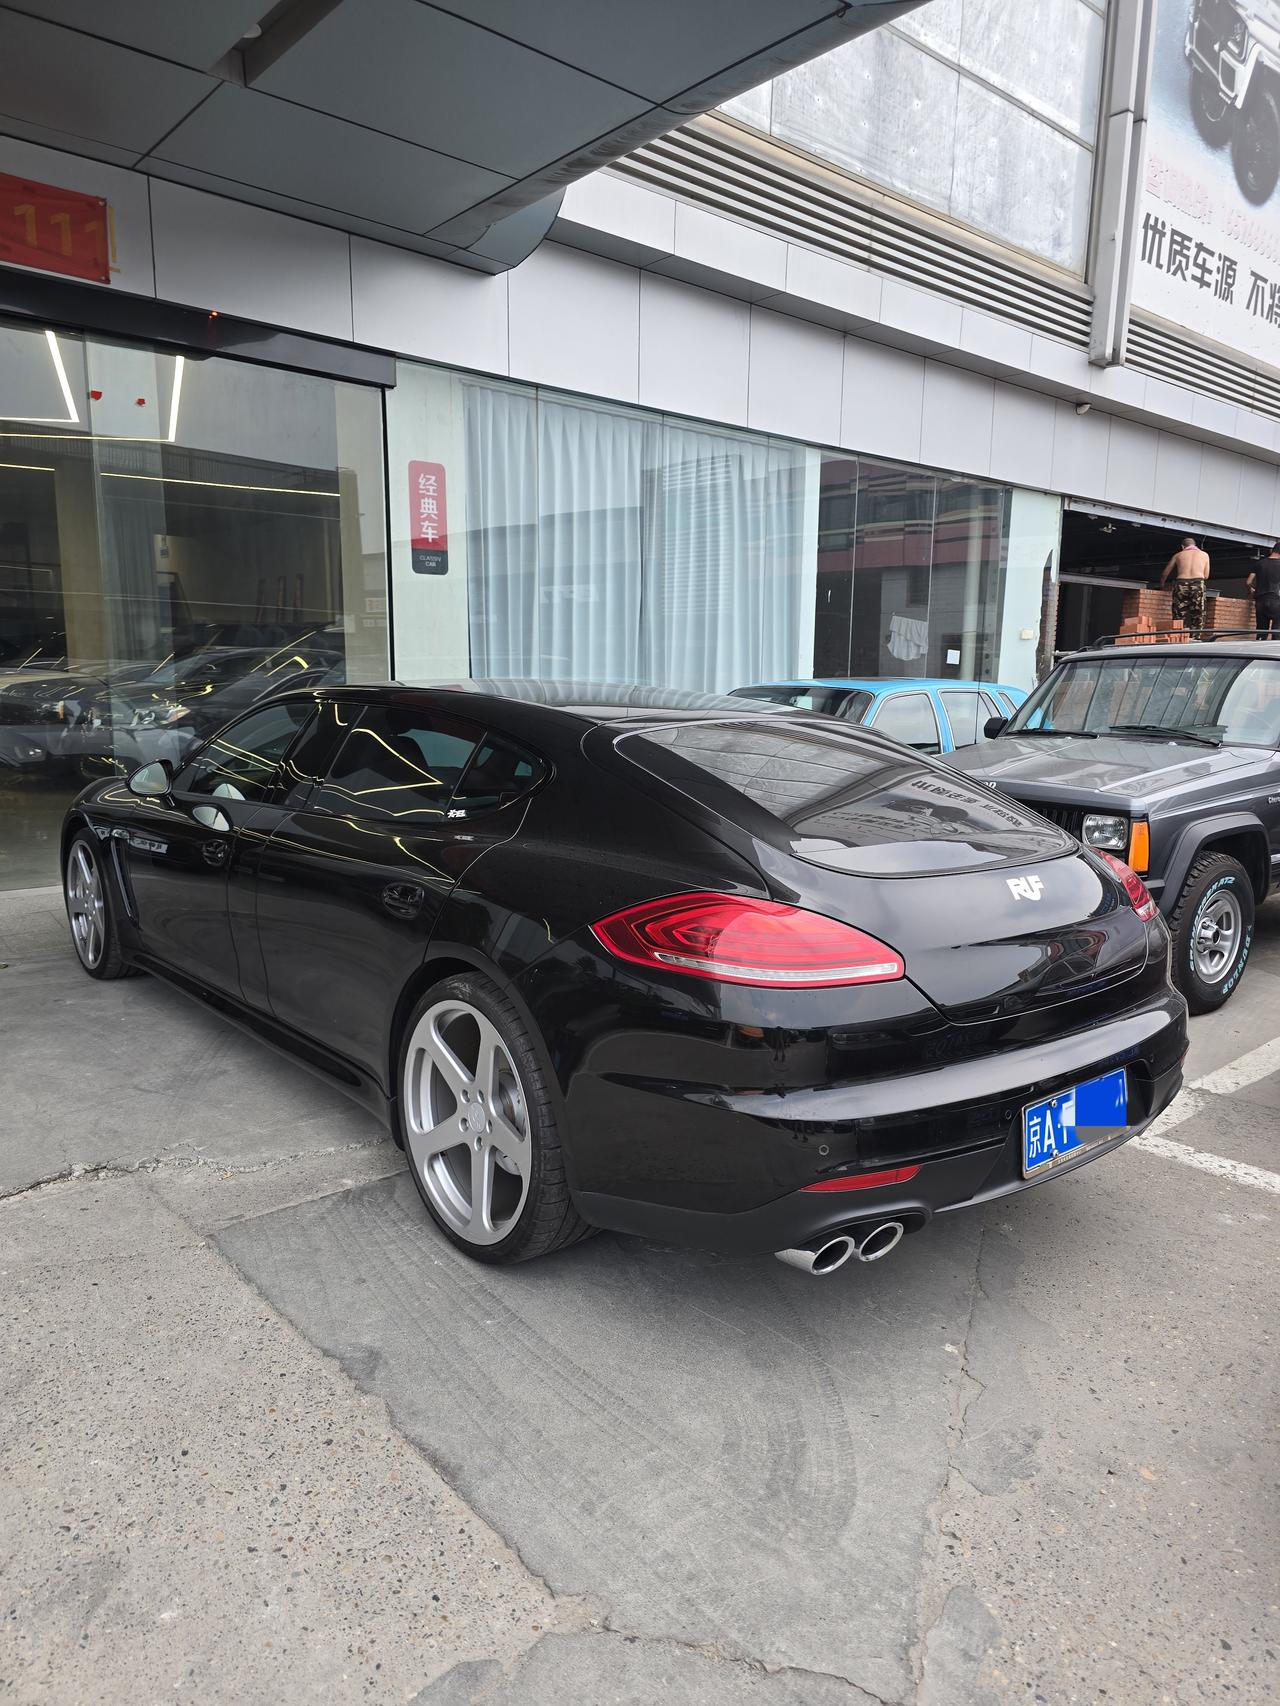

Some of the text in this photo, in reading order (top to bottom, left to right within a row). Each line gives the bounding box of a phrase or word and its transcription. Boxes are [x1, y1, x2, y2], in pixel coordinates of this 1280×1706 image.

[1141, 212, 1238, 305] 优质车源
[418, 473, 439, 543] 经典车
[1006, 875, 1045, 902] RUF
